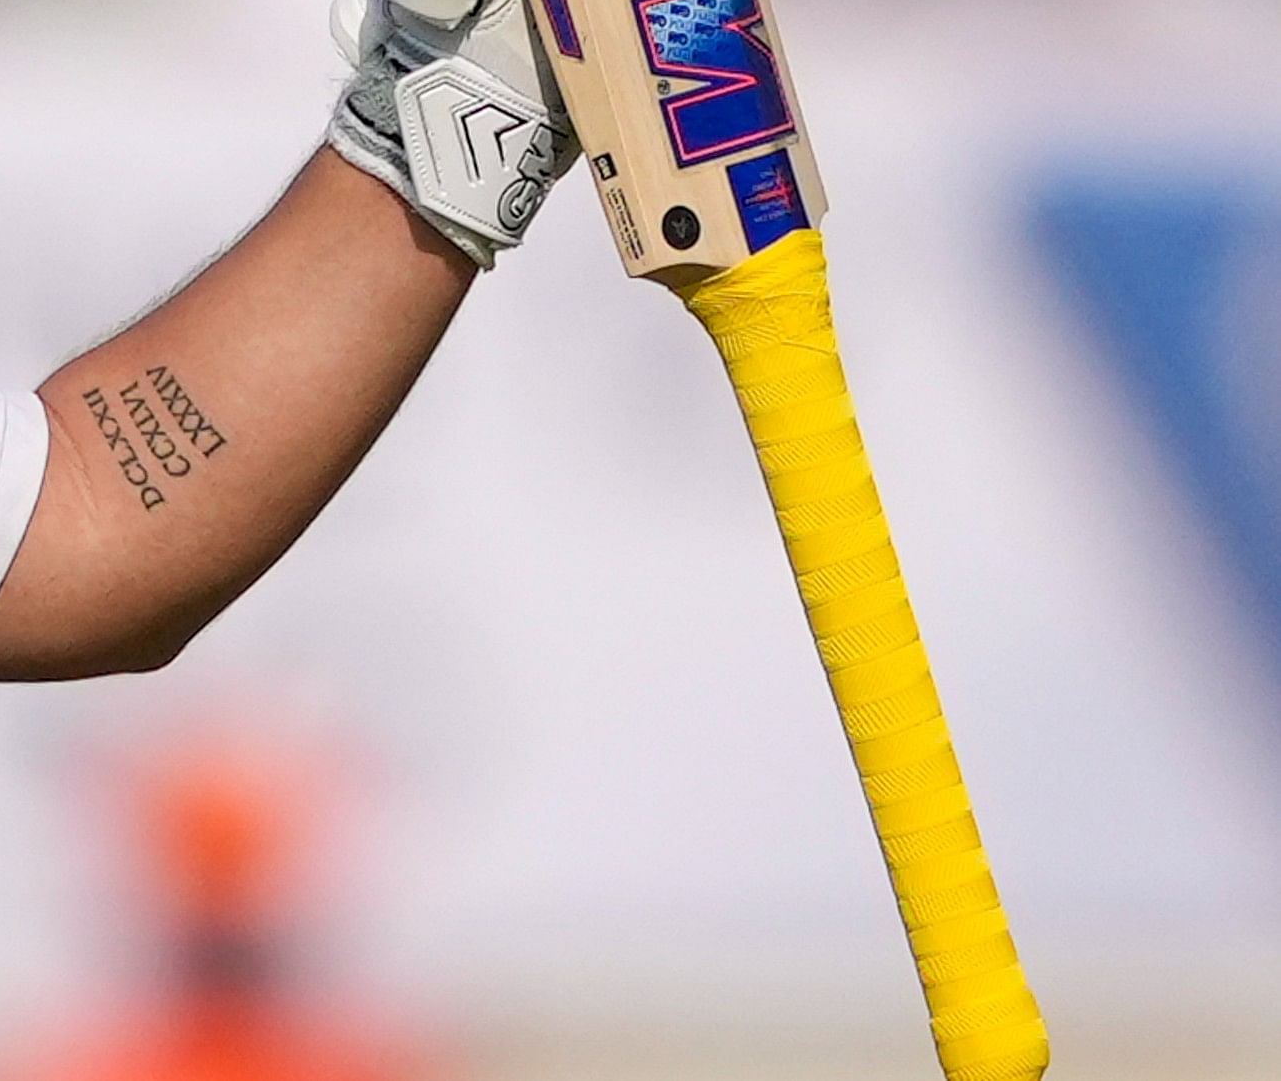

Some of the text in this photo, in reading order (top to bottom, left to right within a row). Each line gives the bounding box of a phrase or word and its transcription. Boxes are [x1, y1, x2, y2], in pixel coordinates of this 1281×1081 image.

[82, 387, 165, 512] DCLXXII
[119, 380, 191, 477] CCXLVI
[146, 366, 228, 459] LXXXIV
